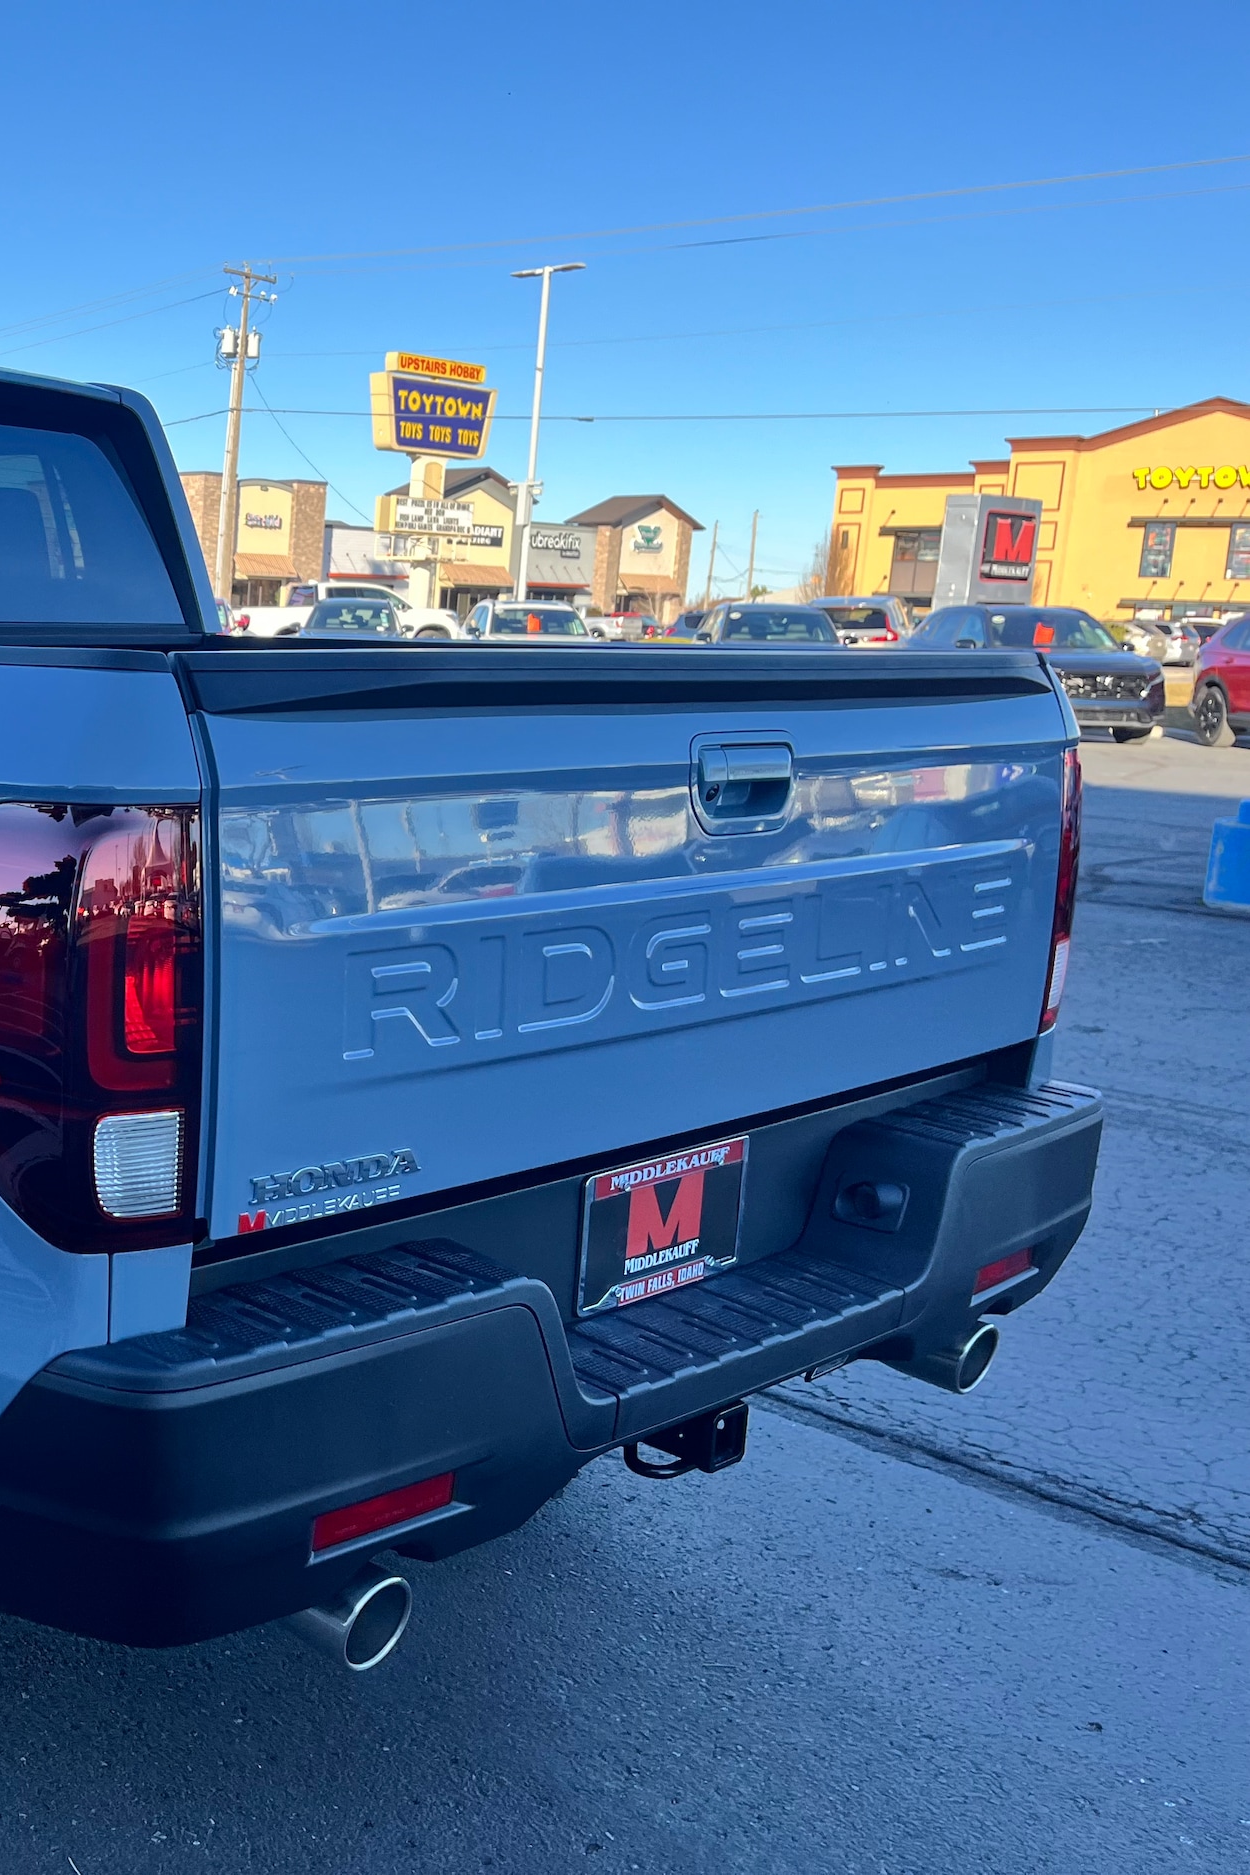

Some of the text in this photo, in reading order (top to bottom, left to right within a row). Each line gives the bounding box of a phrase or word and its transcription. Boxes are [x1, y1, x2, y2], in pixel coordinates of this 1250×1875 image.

[400, 355, 481, 381] UPSTAIRS HOBBY
[398, 390, 483, 420] TOYTOWN
[400, 421, 480, 447] TOYS TOYS TOYS
[993, 517, 1036, 563] M
[343, 864, 1014, 1060] RIDGELINE
[248, 1147, 422, 1205] HONDA
[610, 1146, 730, 1191] MIDDLEKAUFF
[626, 1170, 705, 1259] M
[623, 1239, 700, 1275] MIDDLEKAUFF
[620, 1261, 705, 1302] TWIN FALLS, IDAHO
